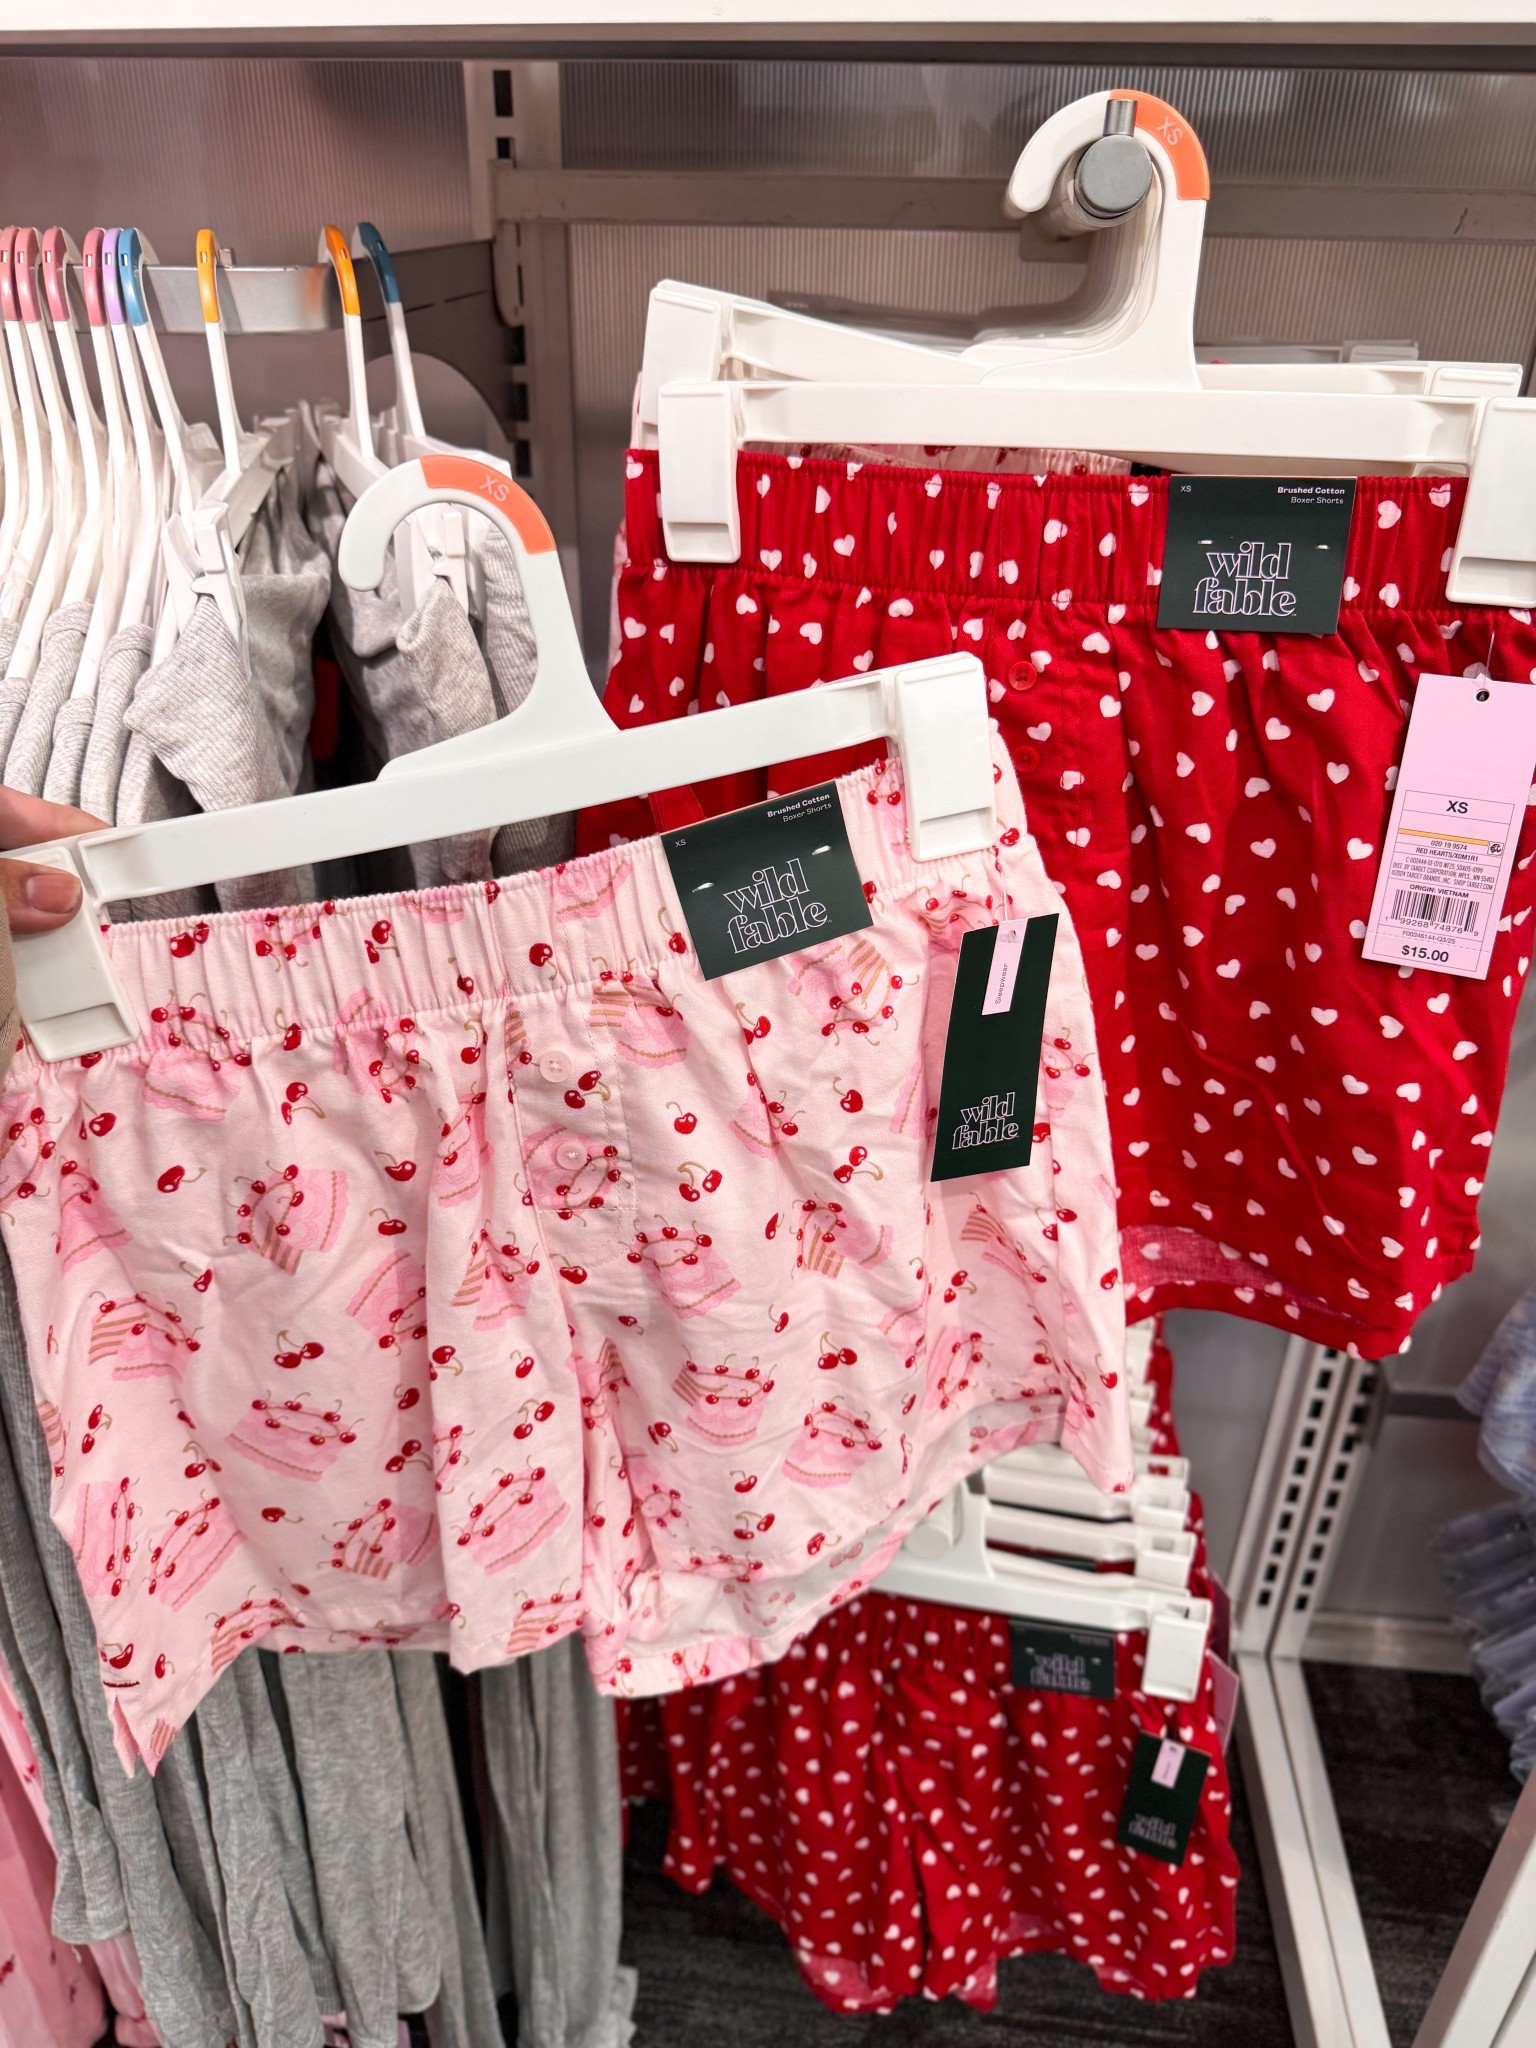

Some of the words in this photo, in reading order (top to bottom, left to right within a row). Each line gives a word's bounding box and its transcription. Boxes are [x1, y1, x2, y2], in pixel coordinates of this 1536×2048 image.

[1156, 116, 1183, 146] XS
[480, 473, 510, 502] XS
[1180, 485, 1192, 493] XS
[1277, 486, 1313, 495] Brushed
[1314, 486, 1345, 495] Cotton
[1290, 496, 1315, 504] Boxer
[1316, 496, 1344, 505] Shorts
[1205, 541, 1292, 580] wild
[1192, 576, 1297, 616] fable
[767, 801, 801, 818] Brushed
[801, 793, 830, 807] Cotton
[782, 810, 805, 823] Boxer
[806, 802, 832, 815] Shorts
[1446, 800, 1469, 815] XS
[675, 838, 687, 848] XS
[1416, 847, 1428, 855] RED
[1452, 843, 1468, 851] 9574
[1406, 871, 1422, 879] TARGET
[1410, 864, 1427, 873] TARGET
[723, 857, 810, 913] wild
[1409, 883, 1436, 893] ORIGIN:
[1438, 888, 1469, 898] VIETNAM
[727, 896, 828, 954] fable
[1399, 917, 1429, 928] 99268
[1434, 922, 1463, 934] 74876
[1401, 944, 1449, 963] $15.00
[995, 963, 1008, 1005] Sleepwear
[960, 1091, 1016, 1124] wild
[952, 1118, 1020, 1150] fable
